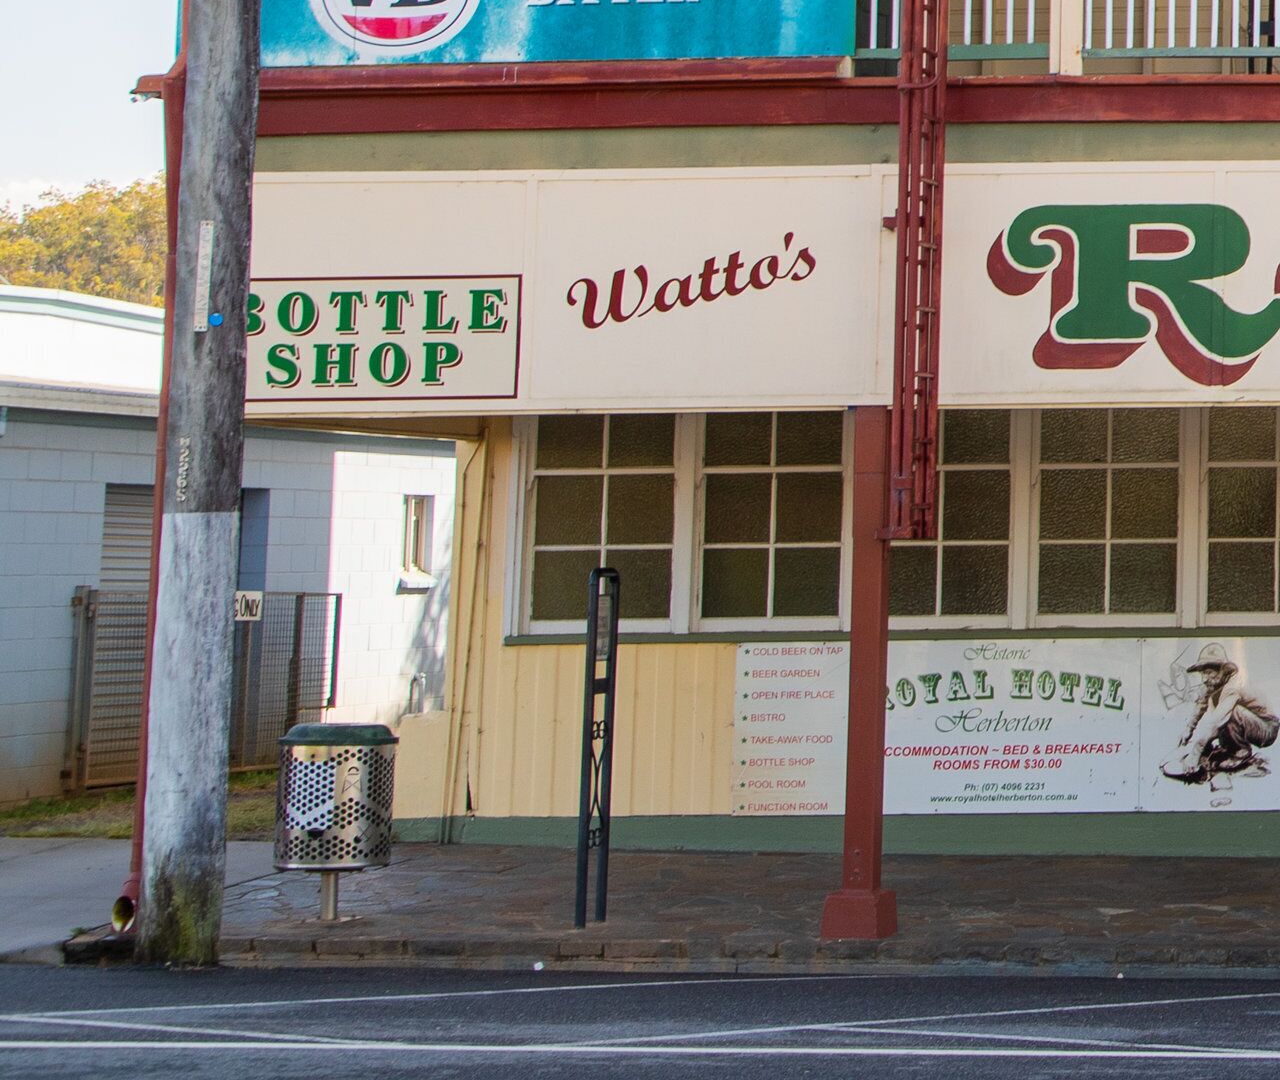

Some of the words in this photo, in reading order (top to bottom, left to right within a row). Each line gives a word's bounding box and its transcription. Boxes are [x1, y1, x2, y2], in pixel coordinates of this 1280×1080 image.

[566, 232, 817, 329] Watto's
[266, 341, 463, 387] SHOP
[240, 594, 261, 617] ONLY
[752, 647, 779, 656] COLD
[781, 646, 807, 656] BEER
[808, 646, 824, 655] ON
[826, 645, 843, 655] TAP
[963, 642, 1032, 662] Historic
[751, 670, 777, 679] BEER
[779, 669, 820, 678] GARDEN
[751, 691, 778, 700] OPEN
[780, 690, 802, 699] FIRE
[804, 690, 836, 699] PLACE
[1009, 668, 1126, 711] HOTEL
[750, 713, 785, 722] BISTRO
[935, 707, 1054, 733] Herberton
[750, 735, 803, 745] TAKE-AWAY
[805, 735, 833, 744] FOOD
[884, 746, 989, 757] CCOMMODATION
[1002, 745, 1030, 755] BED
[1033, 744, 1041, 755] &
[1044, 743, 1122, 755] BREAKFAST
[748, 757, 786, 767] BOTTLE
[788, 757, 815, 767] SHOP
[933, 760, 980, 771] ROOMS
[983, 759, 1021, 770] FROM
[1023, 758, 1063, 770] $30.00
[747, 780, 774, 789] POOL
[776, 779, 806, 789] ROOM
[964, 783, 980, 792] Ph:
[981, 783, 999, 793] (07)
[1001, 782, 1023, 792] 4096
[1024, 782, 1047, 791] 2231
[930, 792, 1078, 804] www.royalhotelherberton.com.au
[747, 802, 797, 812] FUNCTION
[798, 801, 828, 811] ROOM
